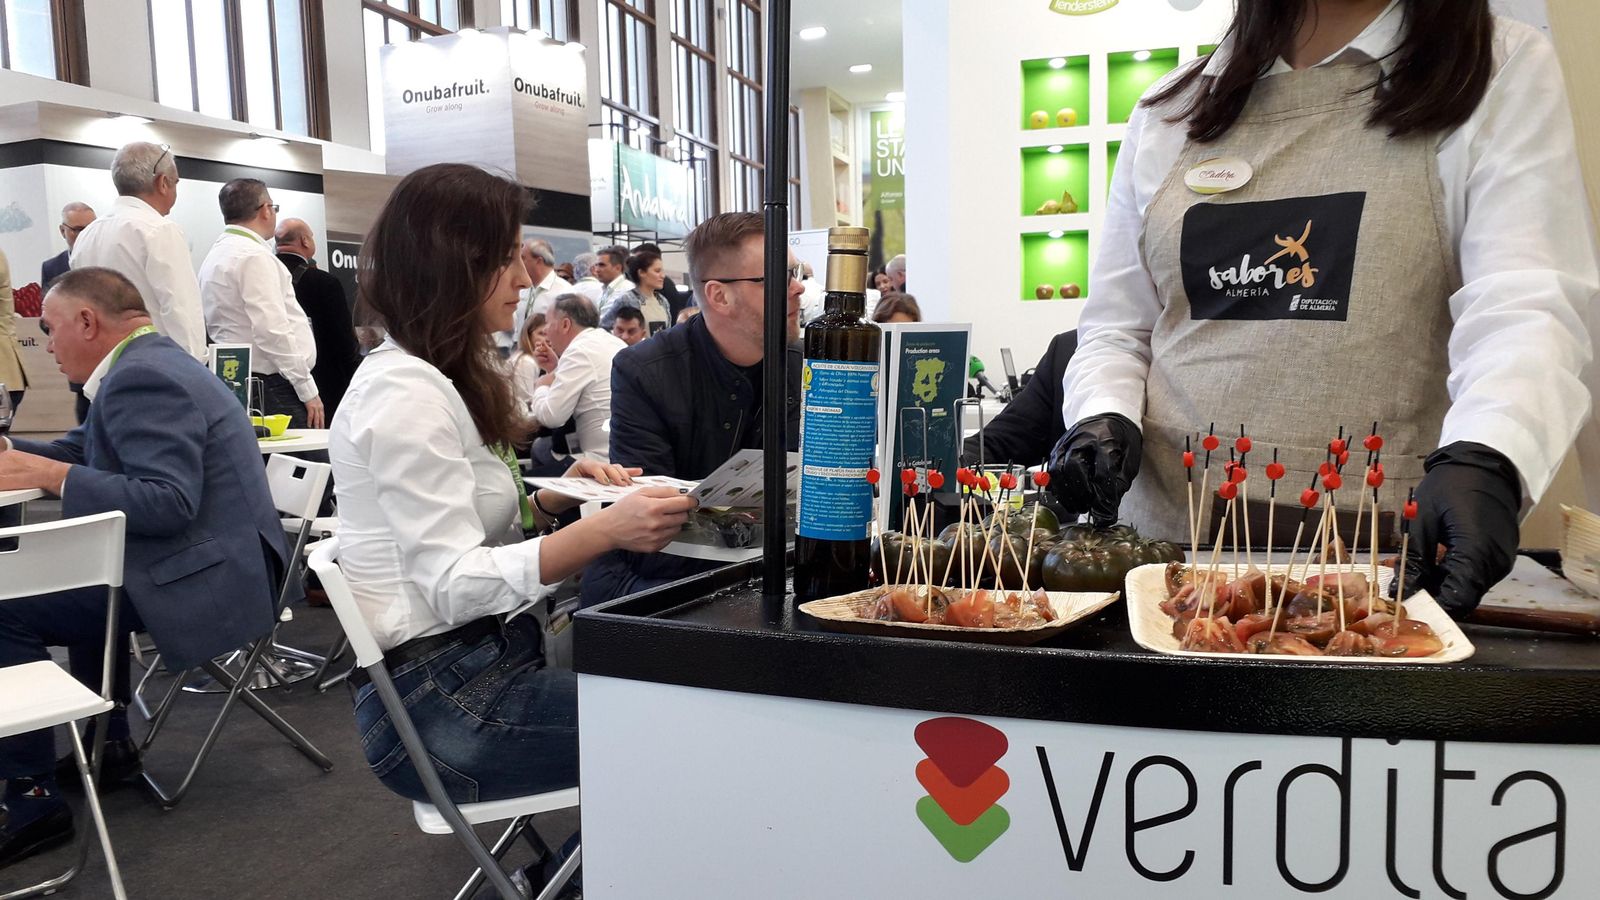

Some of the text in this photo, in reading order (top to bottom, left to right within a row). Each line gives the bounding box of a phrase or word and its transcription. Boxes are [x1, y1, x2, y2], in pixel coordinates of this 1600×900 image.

[402, 79, 490, 104] Onubafruit.
[514, 77, 585, 108] Onubafruit.
[426, 102, 463, 114] Grow along
[534, 101, 565, 116] Grow along
[1208, 253, 1319, 290] sabores
